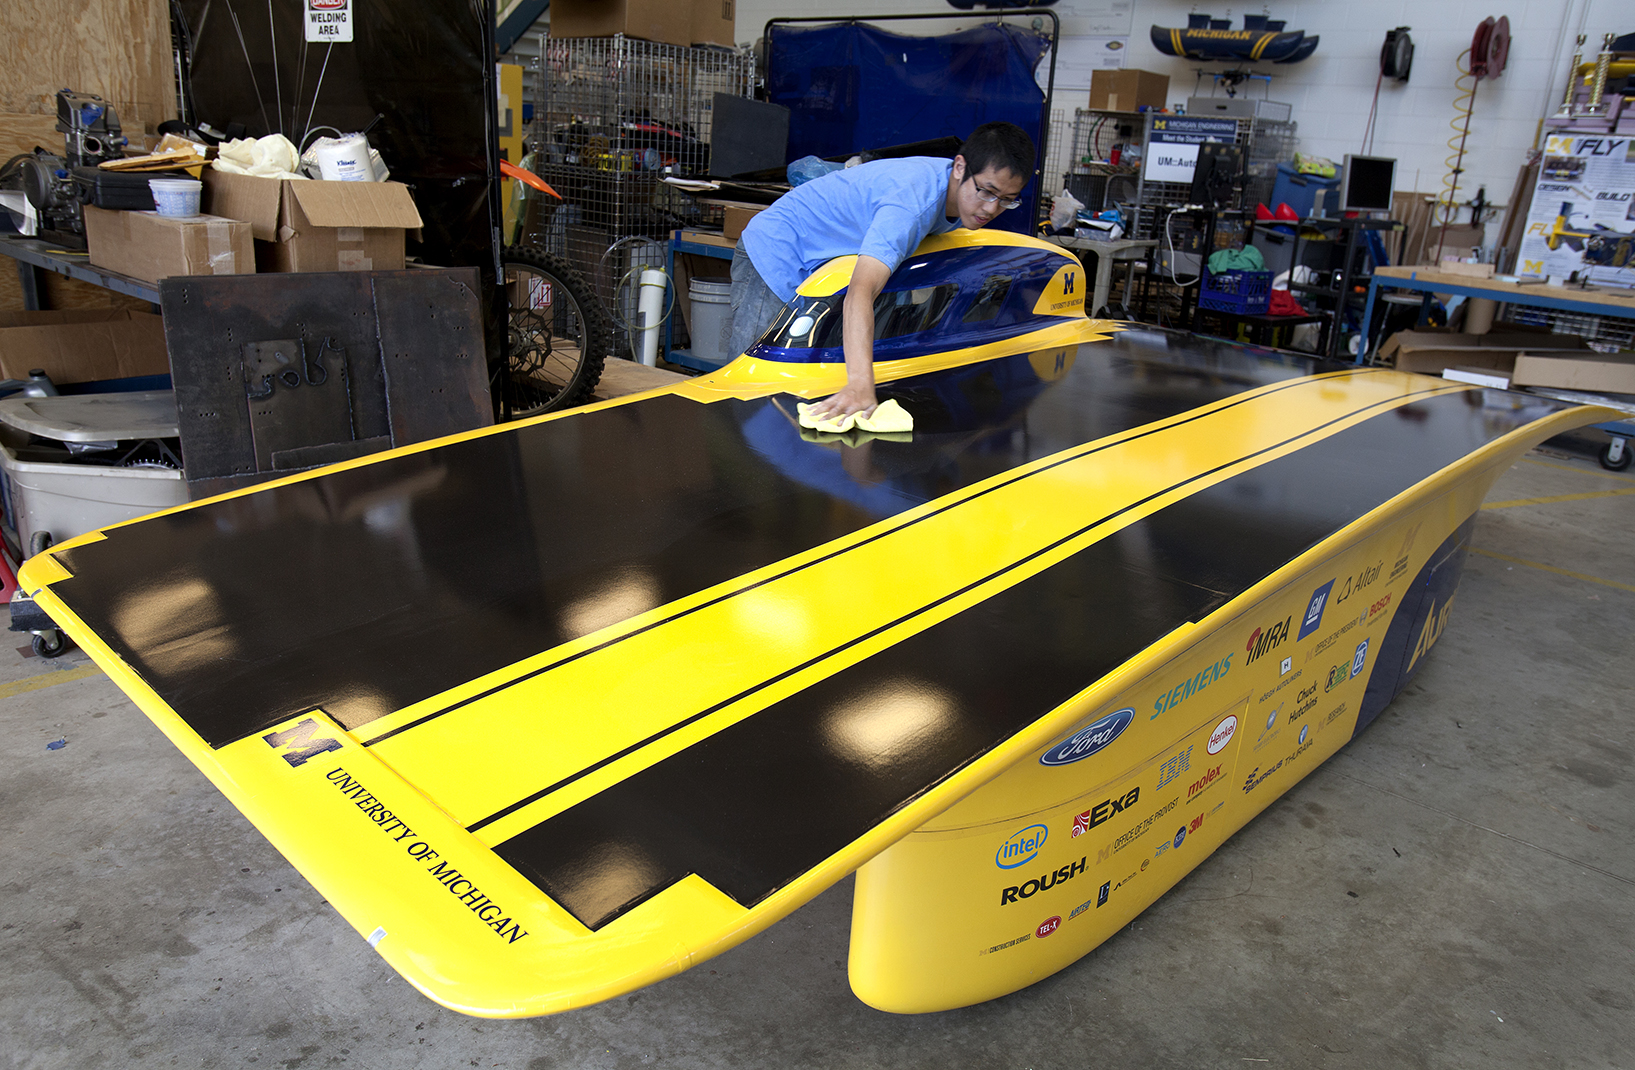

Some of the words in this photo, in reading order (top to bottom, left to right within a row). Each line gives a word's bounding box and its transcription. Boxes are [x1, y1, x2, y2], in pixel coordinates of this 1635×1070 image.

[310, 12, 347, 23] WELDING
[318, 25, 340, 35] AREA
[1186, 29, 1252, 40] MICHIGAN
[1168, 120, 1197, 130] MICHIGAN
[1198, 121, 1235, 131] ENGINEERING
[1538, 184, 1570, 192] DESIGN
[1595, 192, 1631, 201] BUILD
[1527, 222, 1550, 236] FL
[1063, 272, 1074, 294] M
[1050, 300, 1066, 310] UNIVERSITY
[1071, 298, 1083, 306] MICHIGAN
[1352, 559, 1384, 595] Altair
[1308, 593, 1326, 619] GM
[1369, 592, 1393, 617] BOSCH
[1406, 590, 1457, 673] AUR
[1150, 652, 1235, 721] SIEMENS
[1275, 669, 1303, 692] AUTOLINERS
[1297, 680, 1318, 704] Chuck
[1288, 696, 1318, 725] Hutchins
[261, 717, 344, 769] M
[1209, 721, 1235, 750] Henkel
[1156, 745, 1194, 791] IBM
[1187, 762, 1224, 798] molex
[1245, 758, 1284, 795] SEMPRIUS
[1088, 786, 1141, 831] Exa
[1114, 828, 1134, 849] OFFICE
[1134, 822, 1143, 835] OF
[1143, 814, 1154, 829] THE
[1154, 796, 1180, 822] PROVOST
[1188, 812, 1205, 835] 3M
[325, 766, 417, 844] UNIVERSITY
[407, 841, 440, 864] OF
[427, 860, 530, 946] MICHIGAN
[1003, 831, 1041, 859] intel
[1000, 856, 1087, 907] ROUSH
[1039, 920, 1058, 935] TEL-X
[989, 939, 1016, 954] CONSTRUCTION
[1015, 933, 1032, 945] SERVICES
